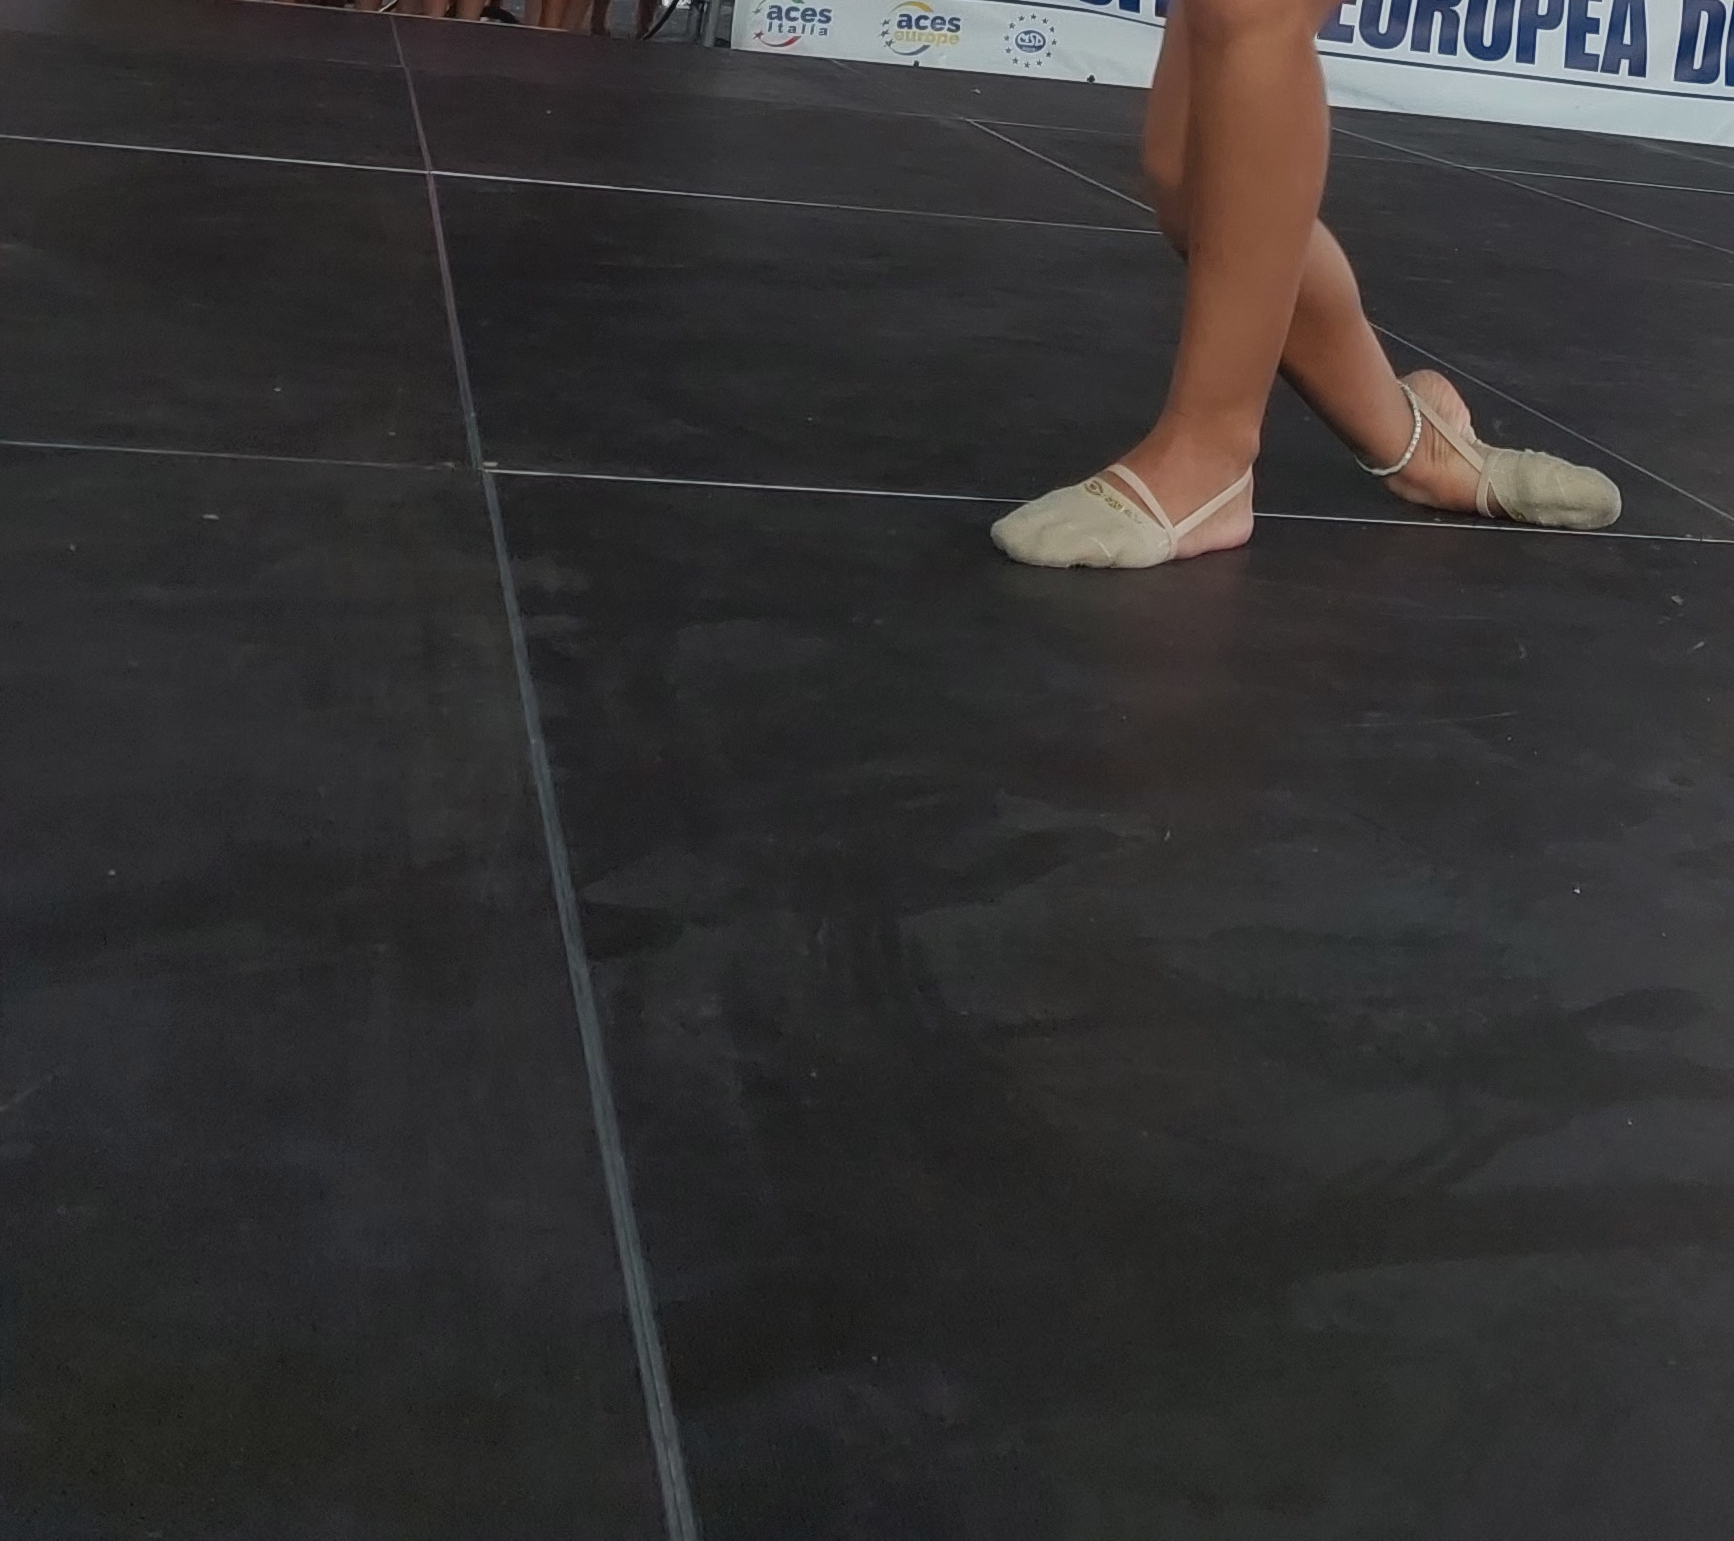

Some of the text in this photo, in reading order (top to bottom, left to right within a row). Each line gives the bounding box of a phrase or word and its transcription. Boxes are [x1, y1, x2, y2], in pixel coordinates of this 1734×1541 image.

[766, 3, 832, 25] aces
[896, 12, 961, 34] aces
[893, 30, 960, 47] europe
